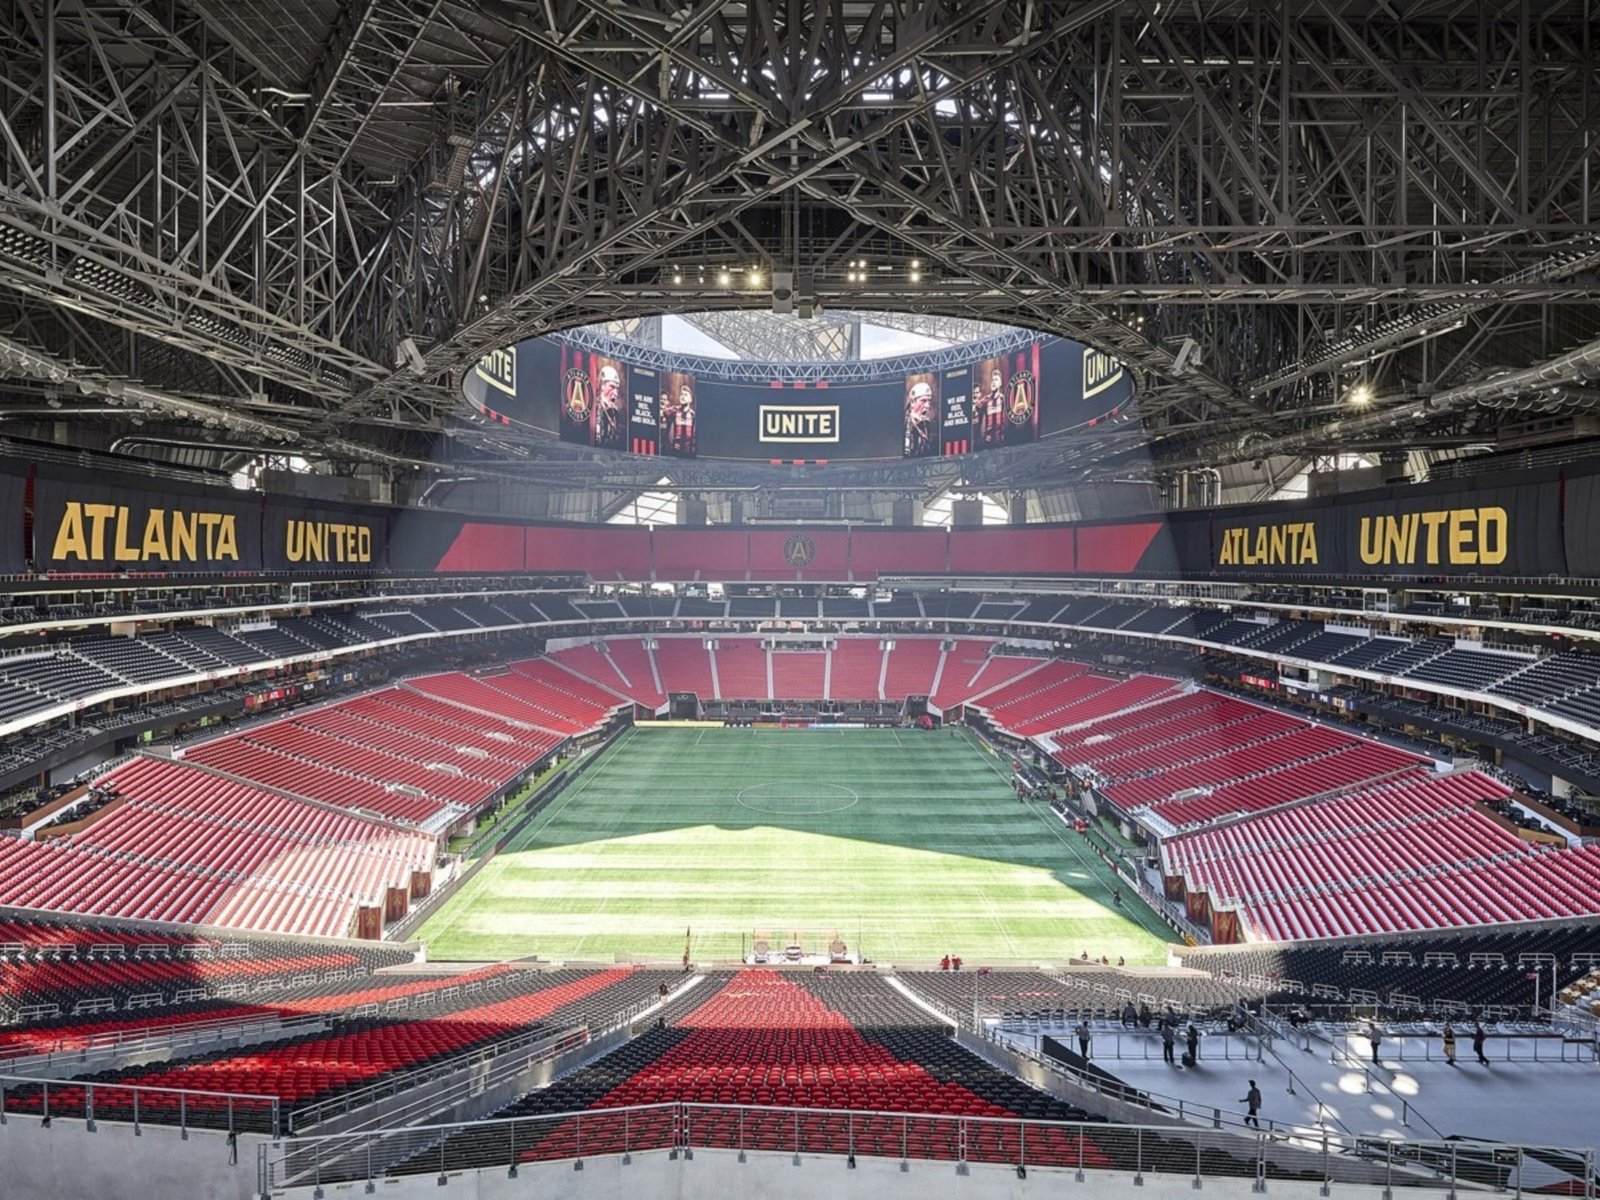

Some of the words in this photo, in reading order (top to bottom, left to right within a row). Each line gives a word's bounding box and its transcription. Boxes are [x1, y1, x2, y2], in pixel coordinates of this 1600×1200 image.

[767, 413, 832, 434] UNITE
[52, 502, 239, 562] ATLANTA
[286, 520, 371, 563] UNITED
[1219, 522, 1318, 565] ATLANTA
[1360, 507, 1508, 565] UNITED
